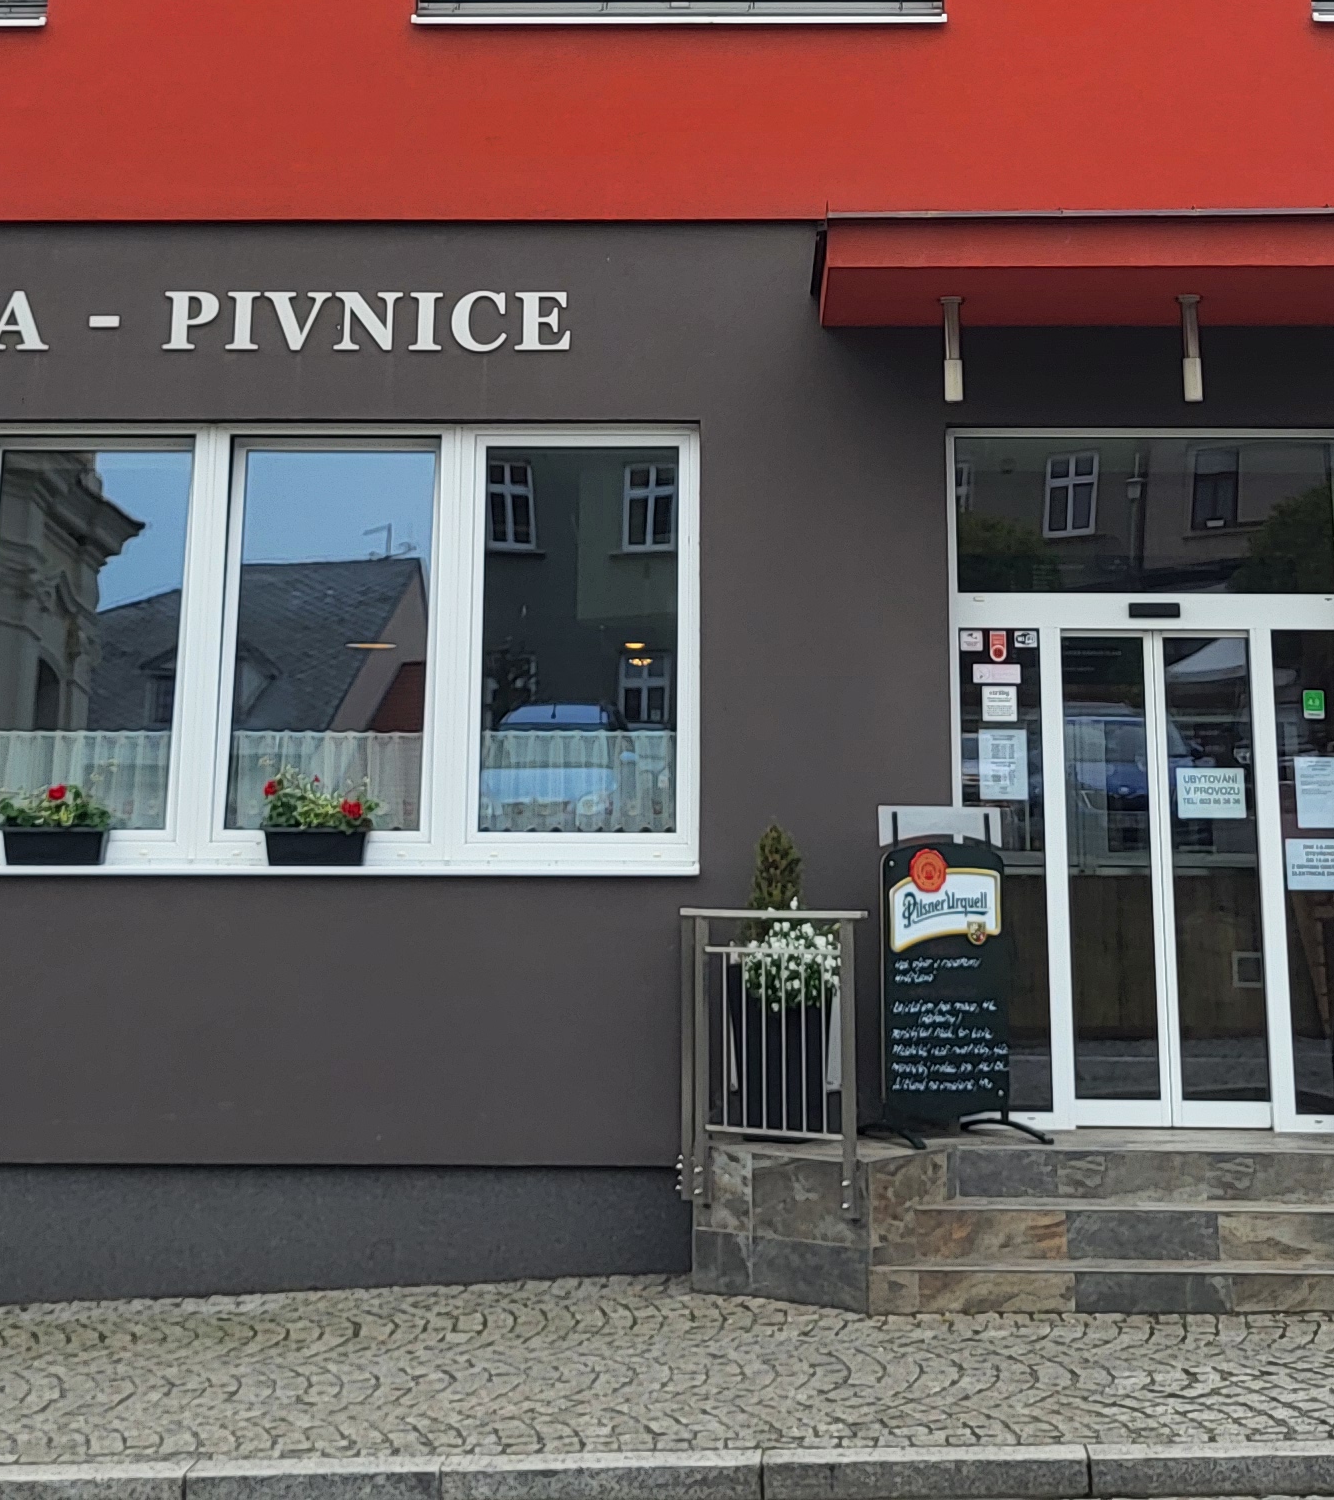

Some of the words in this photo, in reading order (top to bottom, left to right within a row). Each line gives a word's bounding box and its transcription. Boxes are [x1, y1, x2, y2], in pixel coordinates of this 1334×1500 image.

[88, 315, 120, 328] -
[161, 290, 571, 352] PIVNICE
[1183, 773, 1238, 784] UBYTOVÁNÍ
[1184, 786, 1191, 795] V
[1193, 786, 1240, 796] PROVOZU
[902, 891, 945, 928] Pilsner
[945, 891, 987, 917] Urquell
